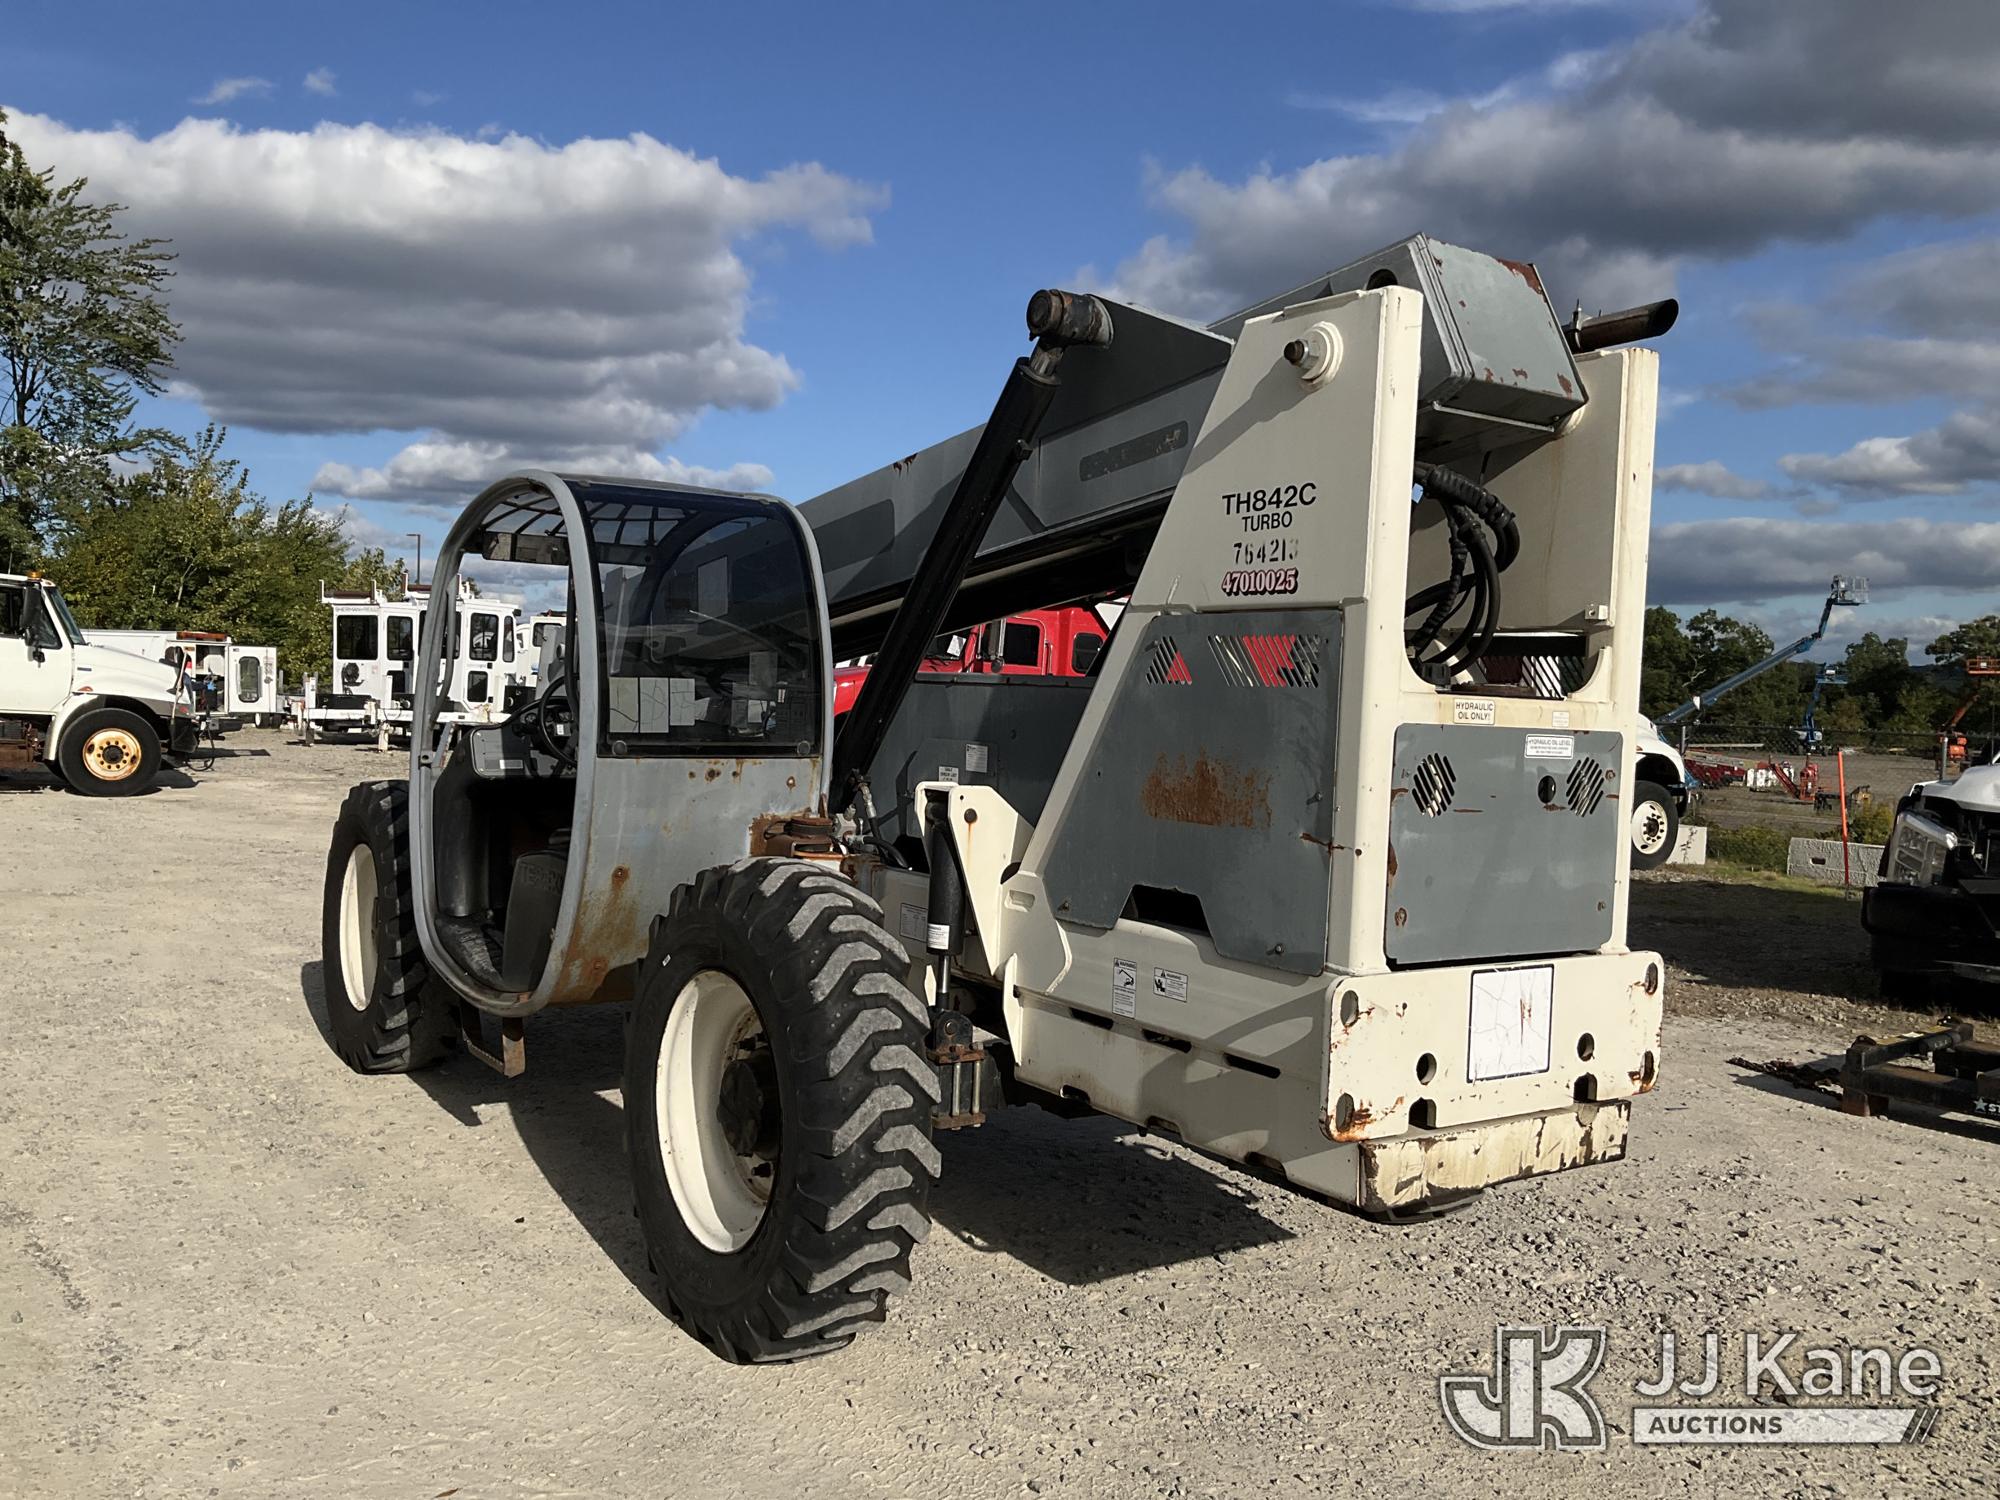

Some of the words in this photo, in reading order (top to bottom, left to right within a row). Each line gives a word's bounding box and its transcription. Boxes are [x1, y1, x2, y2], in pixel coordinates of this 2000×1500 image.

[1222, 483, 1316, 515] TH842C
[1242, 511, 1293, 532] TURBO
[1222, 567, 1298, 596] 47010025
[1455, 701, 1494, 712] HYDRAULIC
[1458, 711, 1469, 720] OIL
